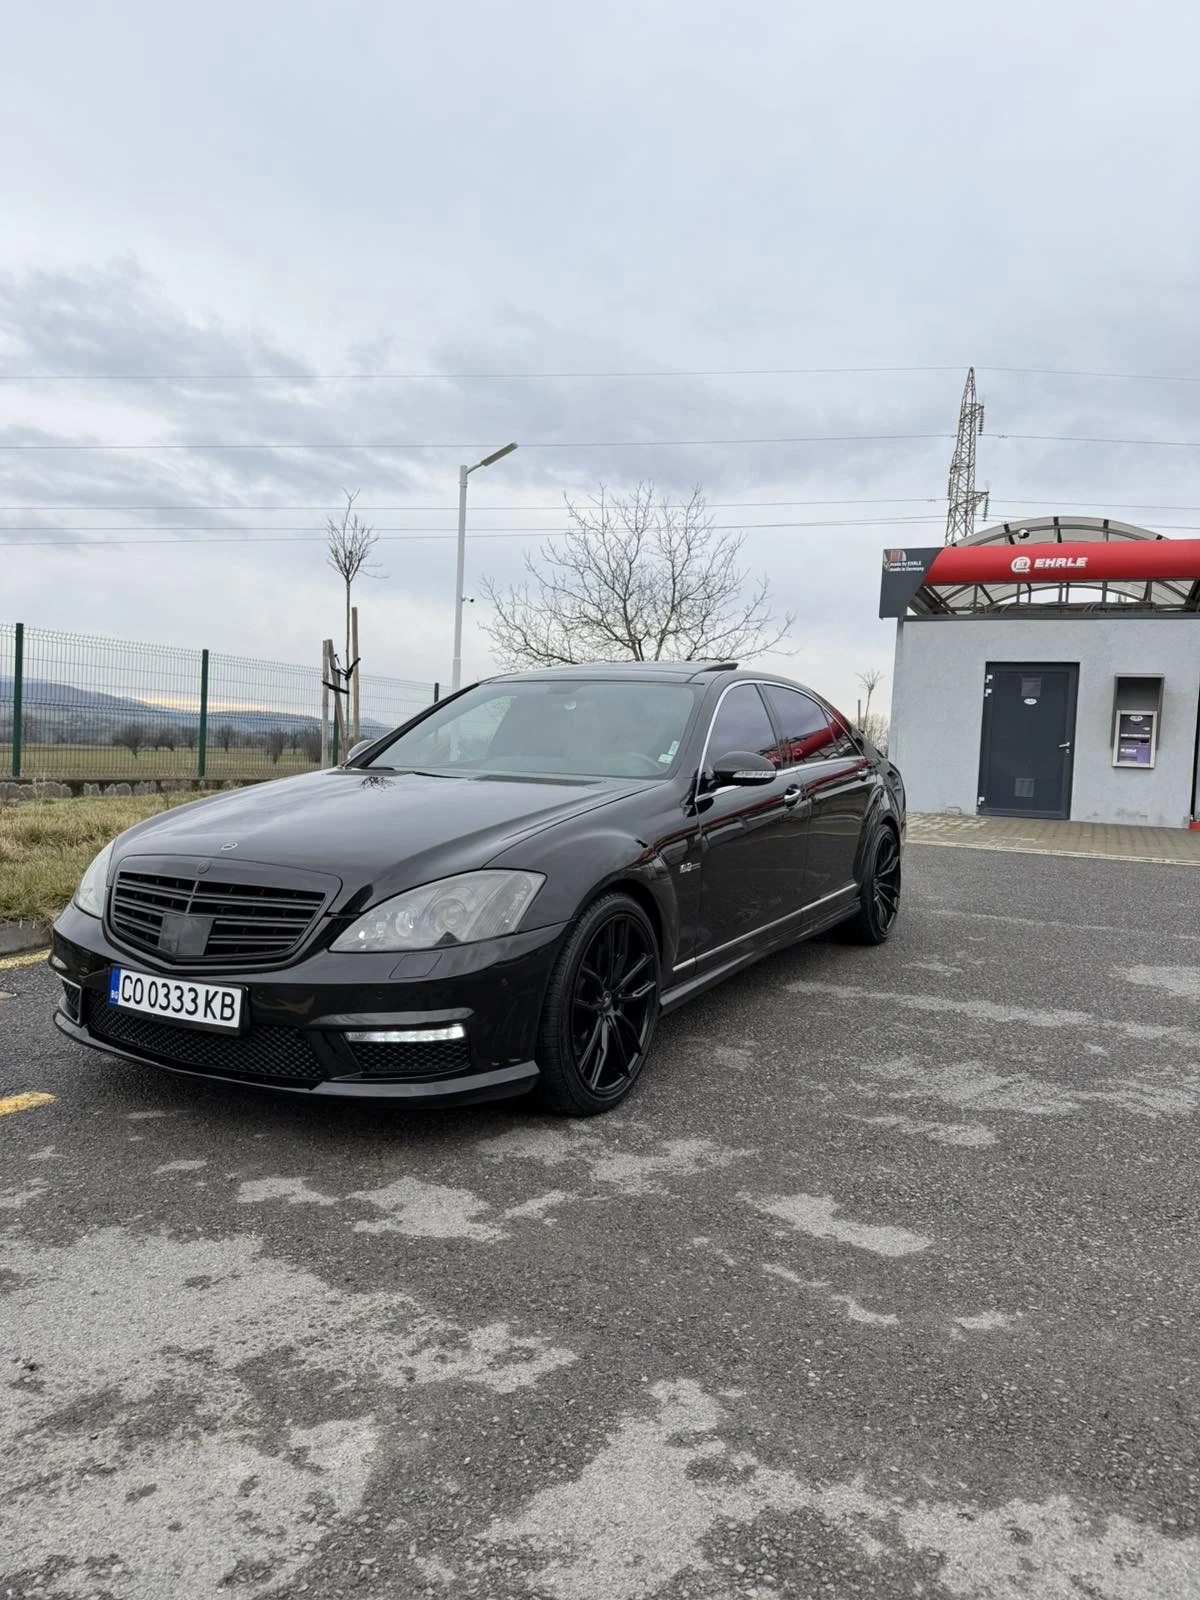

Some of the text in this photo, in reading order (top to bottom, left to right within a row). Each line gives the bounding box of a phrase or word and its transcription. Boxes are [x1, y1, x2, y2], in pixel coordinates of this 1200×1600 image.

[1034, 557, 1088, 569] EHRLE
[121, 974, 235, 1022] CO 0333 KB
